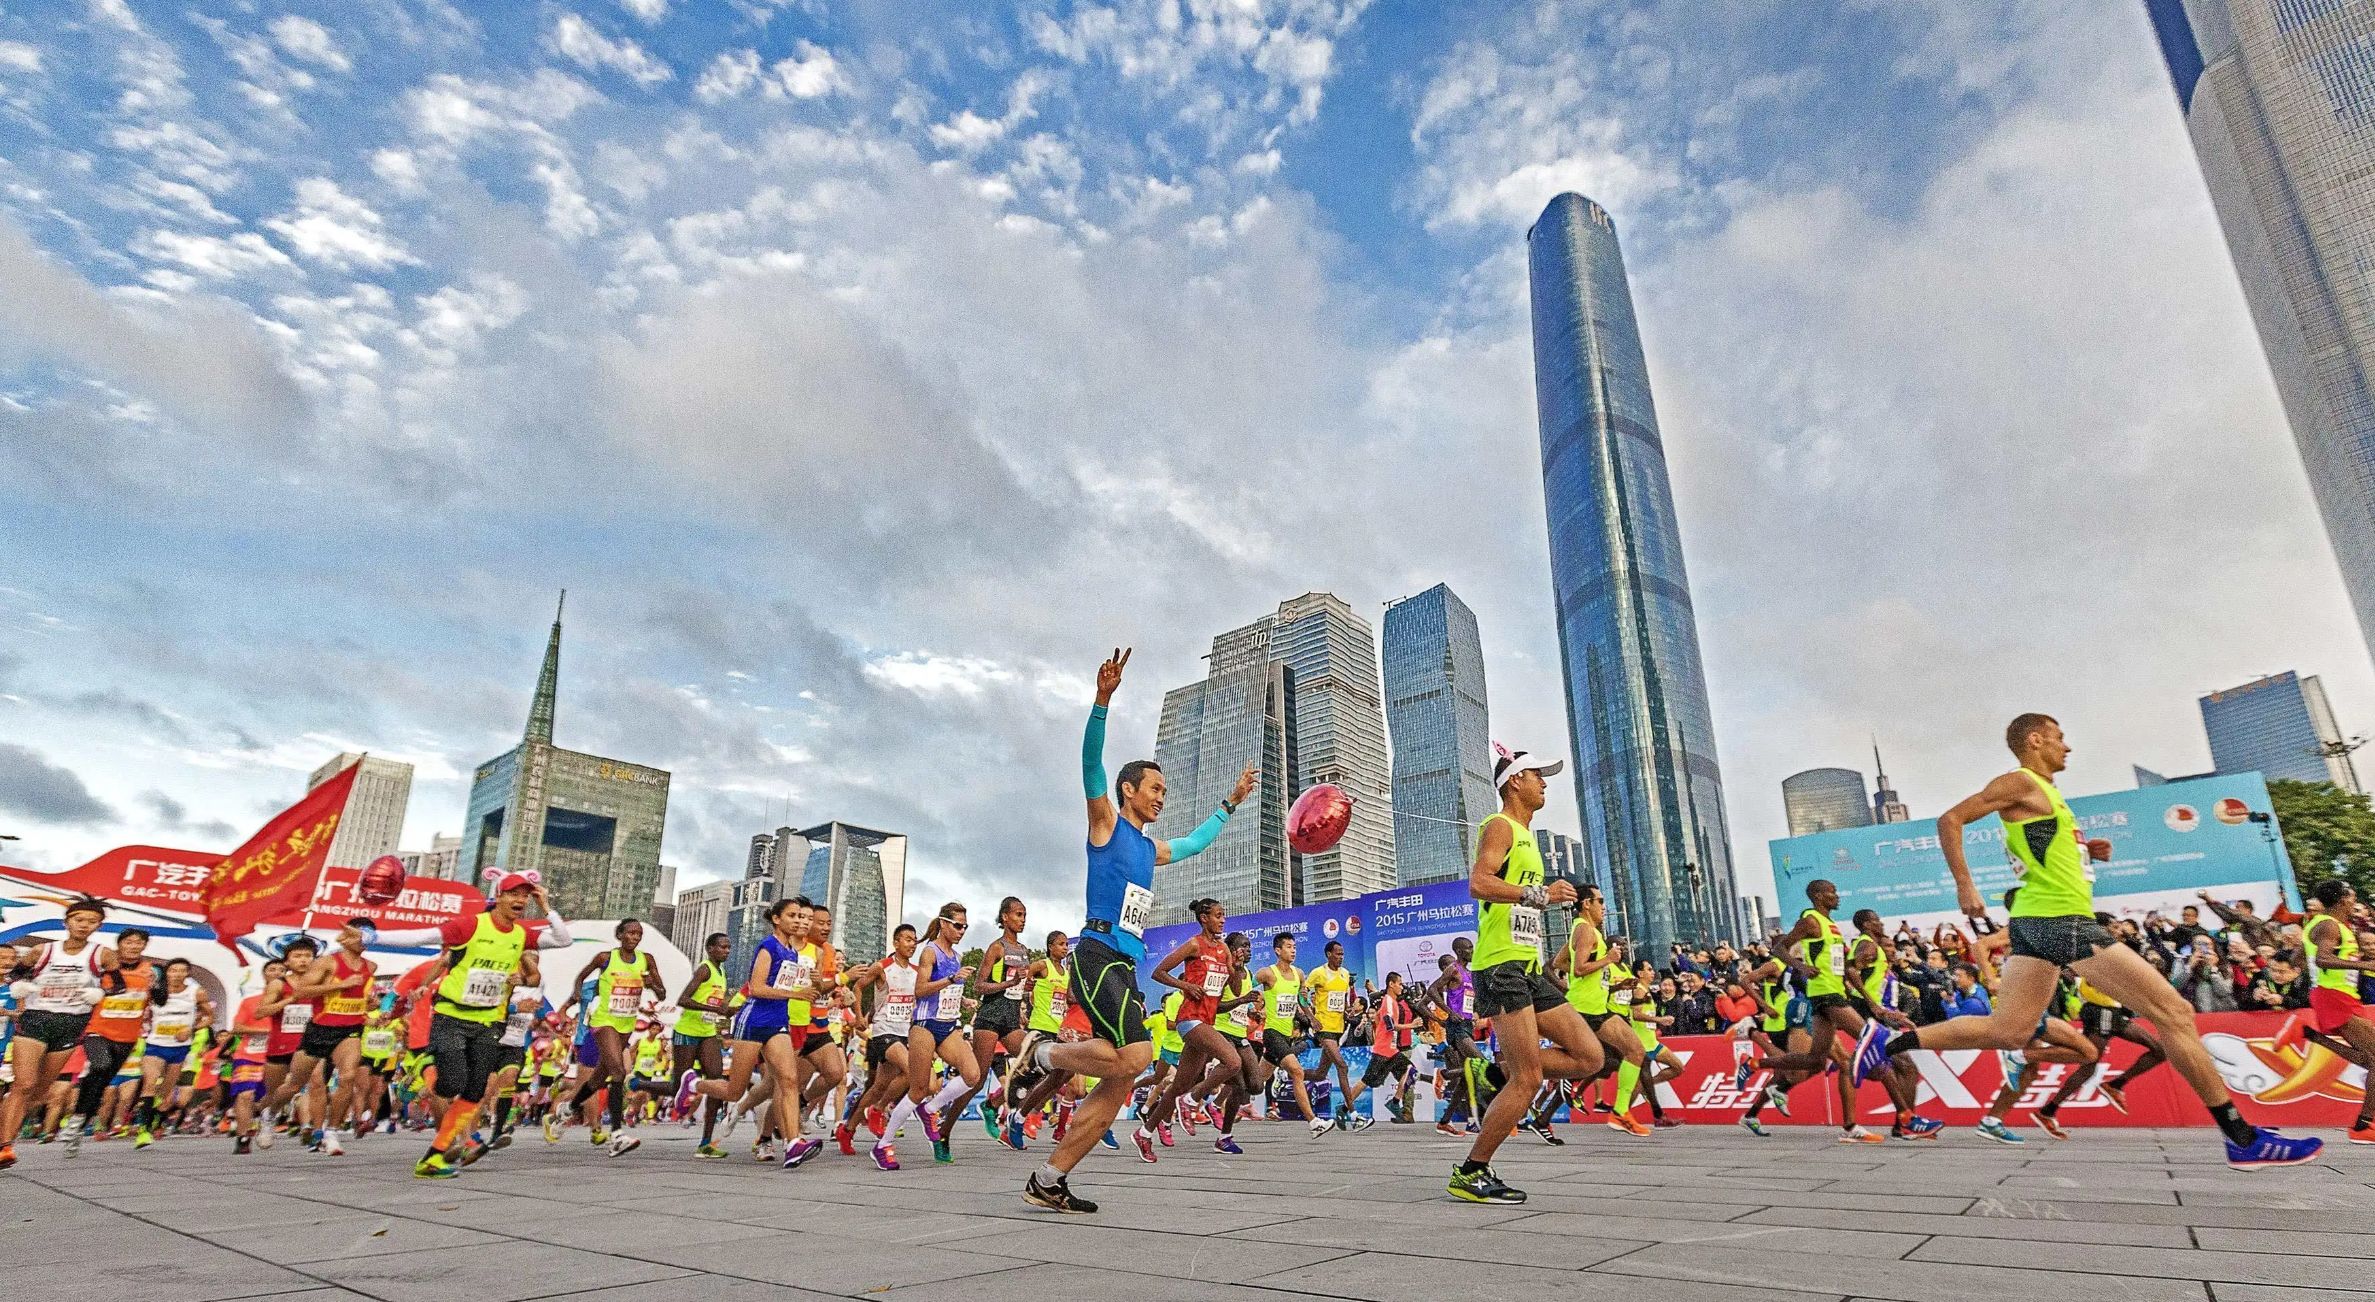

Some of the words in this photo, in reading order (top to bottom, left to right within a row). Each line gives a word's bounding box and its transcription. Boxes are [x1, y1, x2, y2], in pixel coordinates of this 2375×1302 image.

[1374, 893, 1423, 912] 广汽丰田
[1375, 912, 1405, 928] 2015
